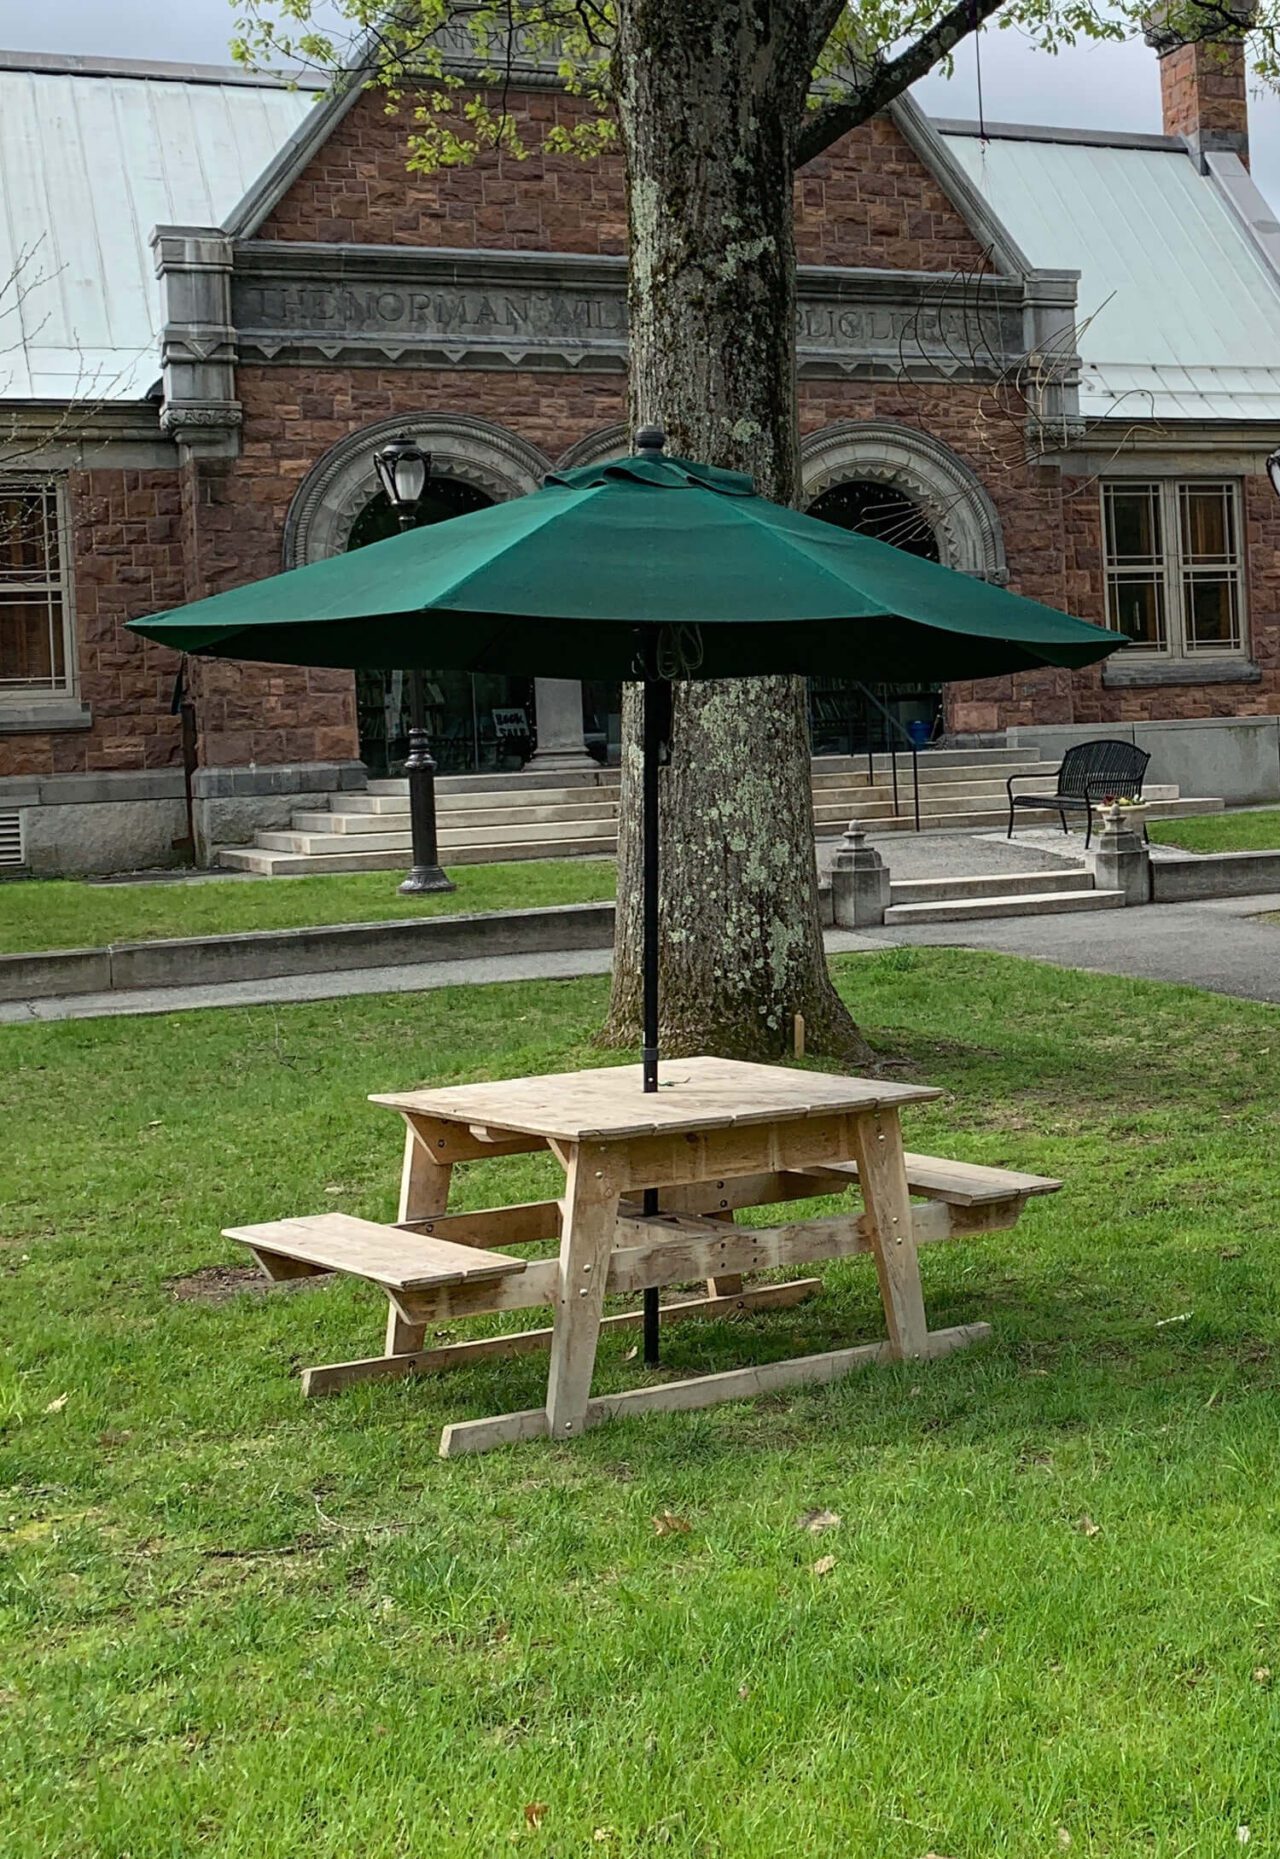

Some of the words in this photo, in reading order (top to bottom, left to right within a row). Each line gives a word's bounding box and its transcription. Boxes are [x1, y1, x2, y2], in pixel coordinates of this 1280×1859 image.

[248, 286, 336, 320] THE
[343, 289, 533, 328] NORMAN
[867, 311, 1008, 344] LIBRARY
